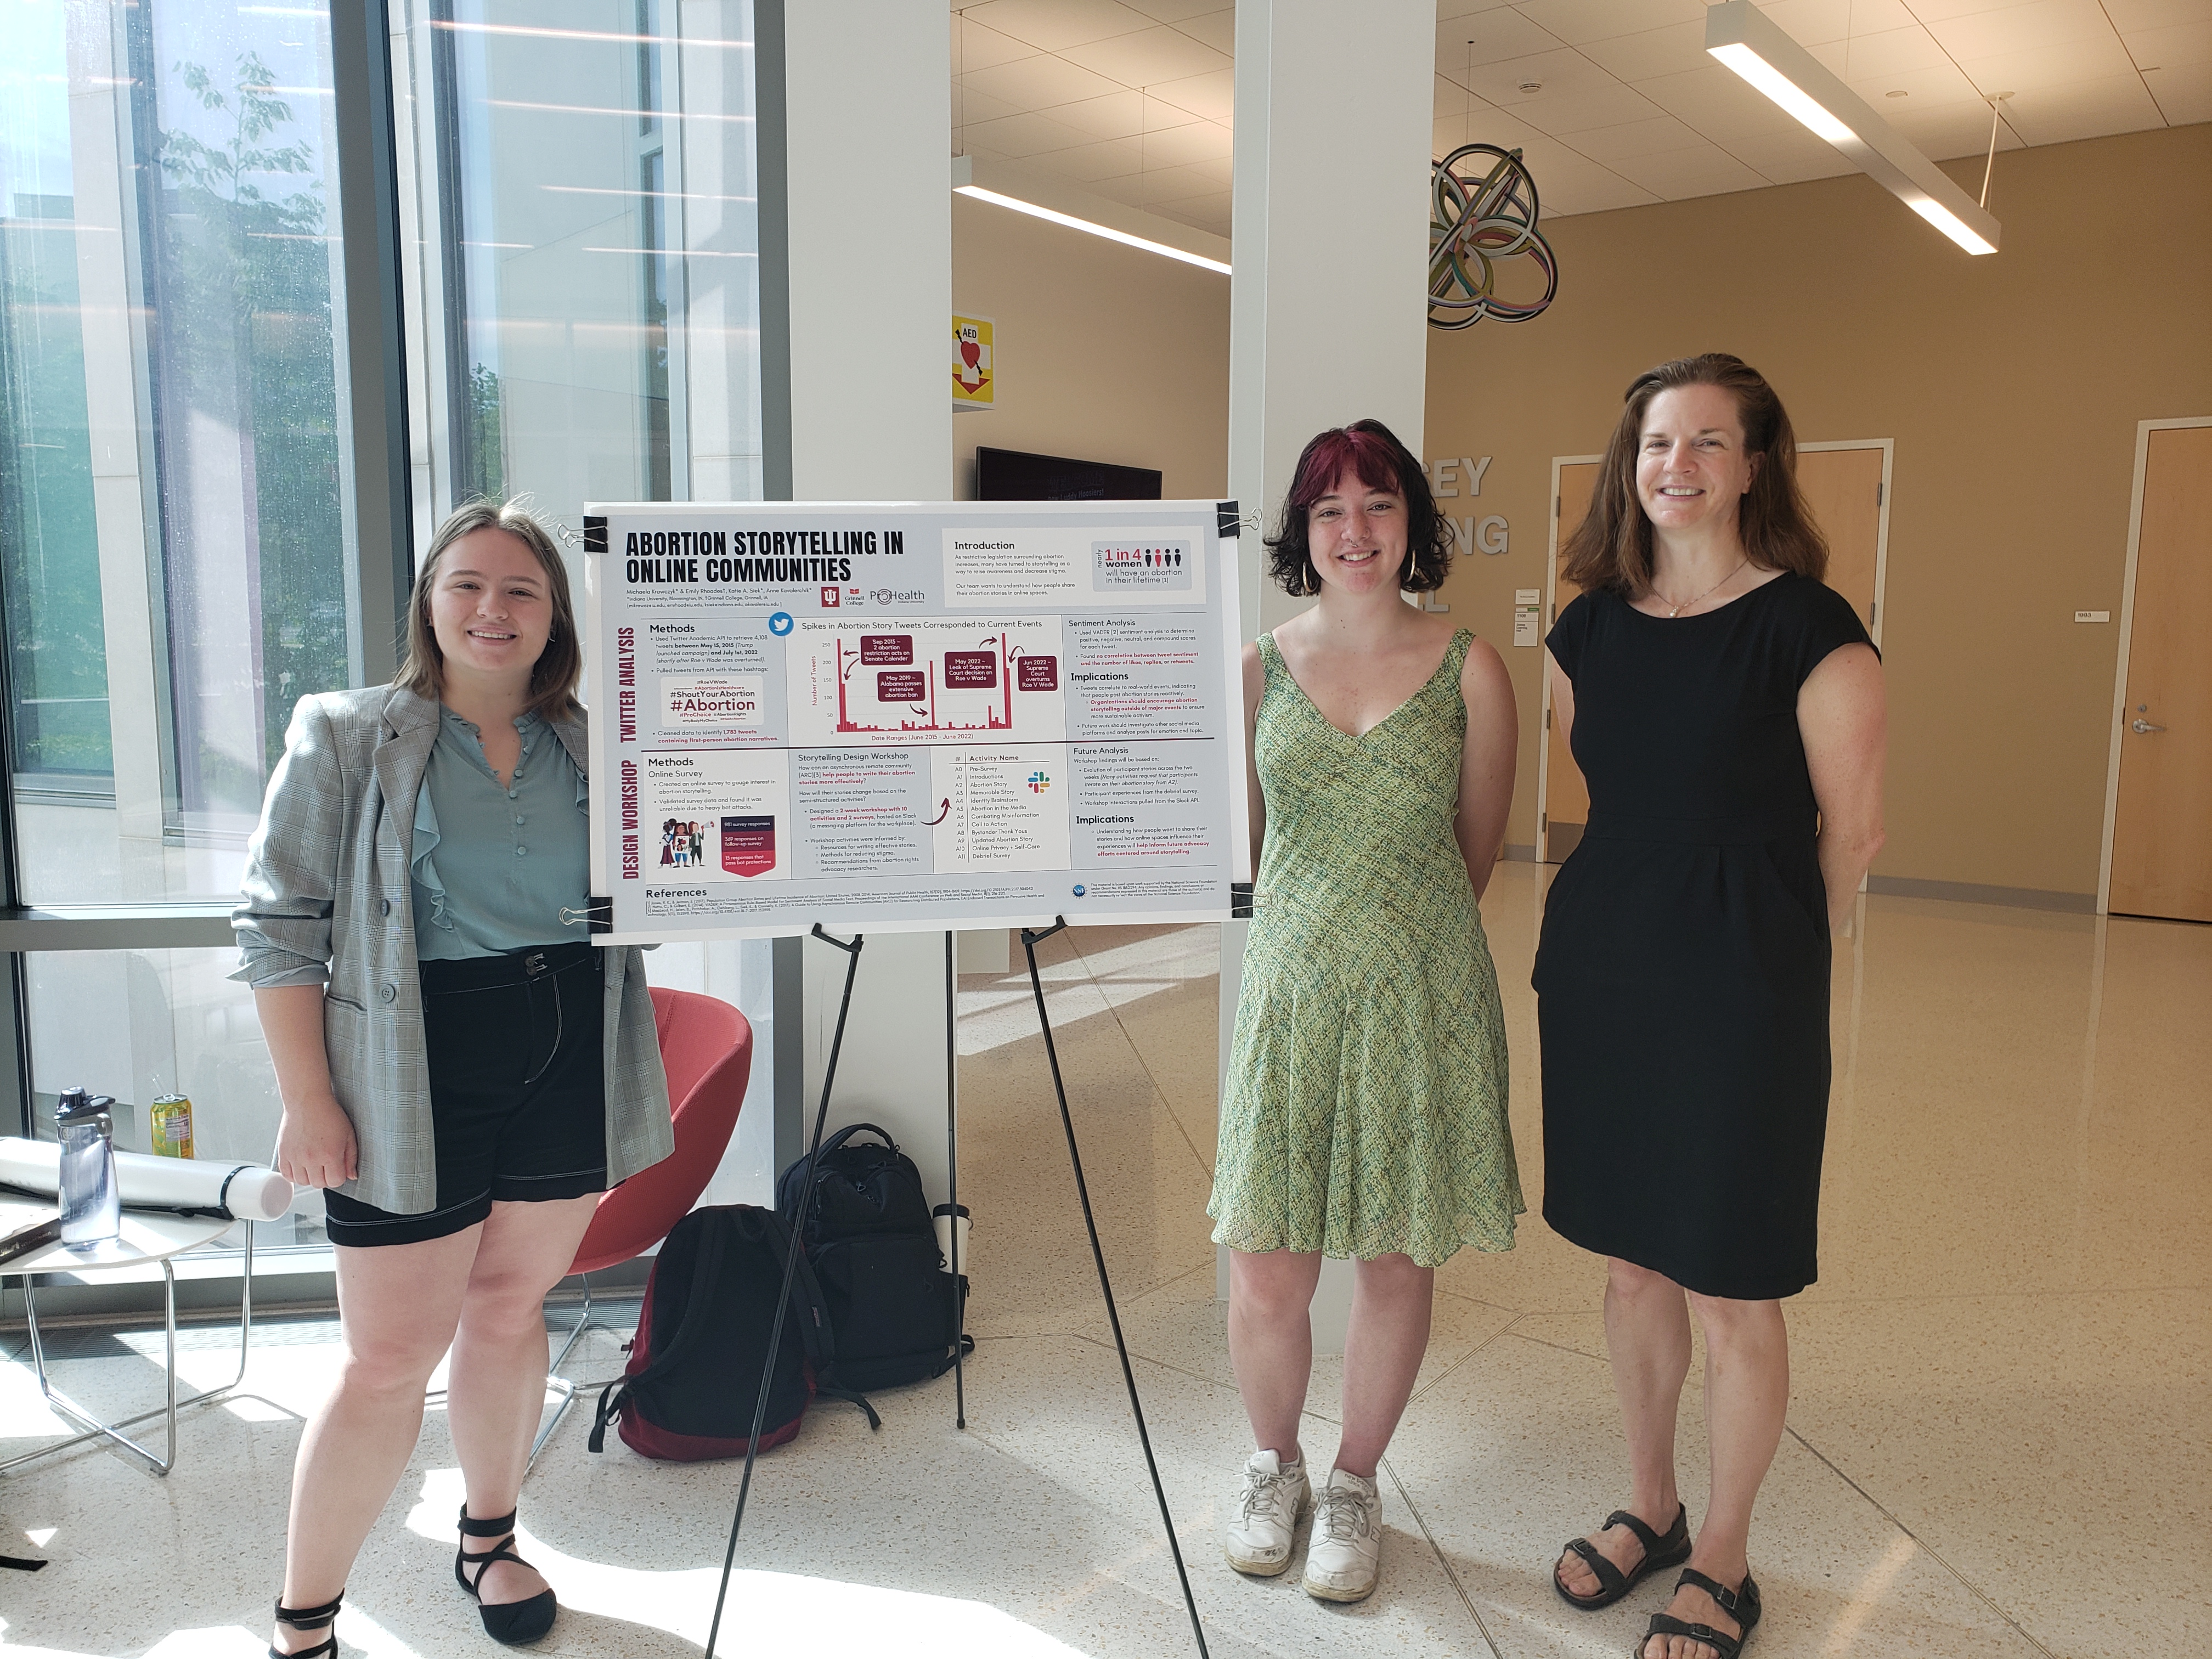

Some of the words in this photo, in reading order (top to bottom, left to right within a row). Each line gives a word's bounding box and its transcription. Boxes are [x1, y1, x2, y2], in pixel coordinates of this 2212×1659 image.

[962, 328, 977, 338] AED
[626, 532, 726, 556] ABORTION
[734, 531, 876, 555] STORYTELLING
[884, 531, 903, 554] IN
[955, 541, 1014, 550] Introduction
[1105, 549, 1113, 561] 1
[1116, 548, 1128, 560] in
[1132, 549, 1141, 560] 4
[627, 558, 698, 583] ONLINE
[706, 557, 851, 582] COMMUNITIES
[1150, 568, 1182, 576] abortion
[650, 623, 695, 633] Methods
[802, 622, 826, 631] Spikes
[872, 622, 892, 630] Story
[923, 620, 975, 630] Corresponded
[1106, 619, 1135, 628] Analysis
[619, 627, 635, 686] ANALYSIS
[1071, 672, 1128, 683] Implications
[670, 698, 754, 711] #Abortion
[620, 690, 636, 743] TWITTER
[1099, 747, 1128, 755] Analysis
[648, 757, 693, 766] Methods
[798, 753, 840, 763] Storytelling
[843, 753, 868, 761] Design
[871, 752, 909, 760] Workshop
[675, 770, 702, 778] Survey
[621, 760, 638, 830] WORKSHOP
[1076, 814, 1134, 826] Implications
[623, 834, 639, 879] DESIGN
[646, 888, 707, 898] References
